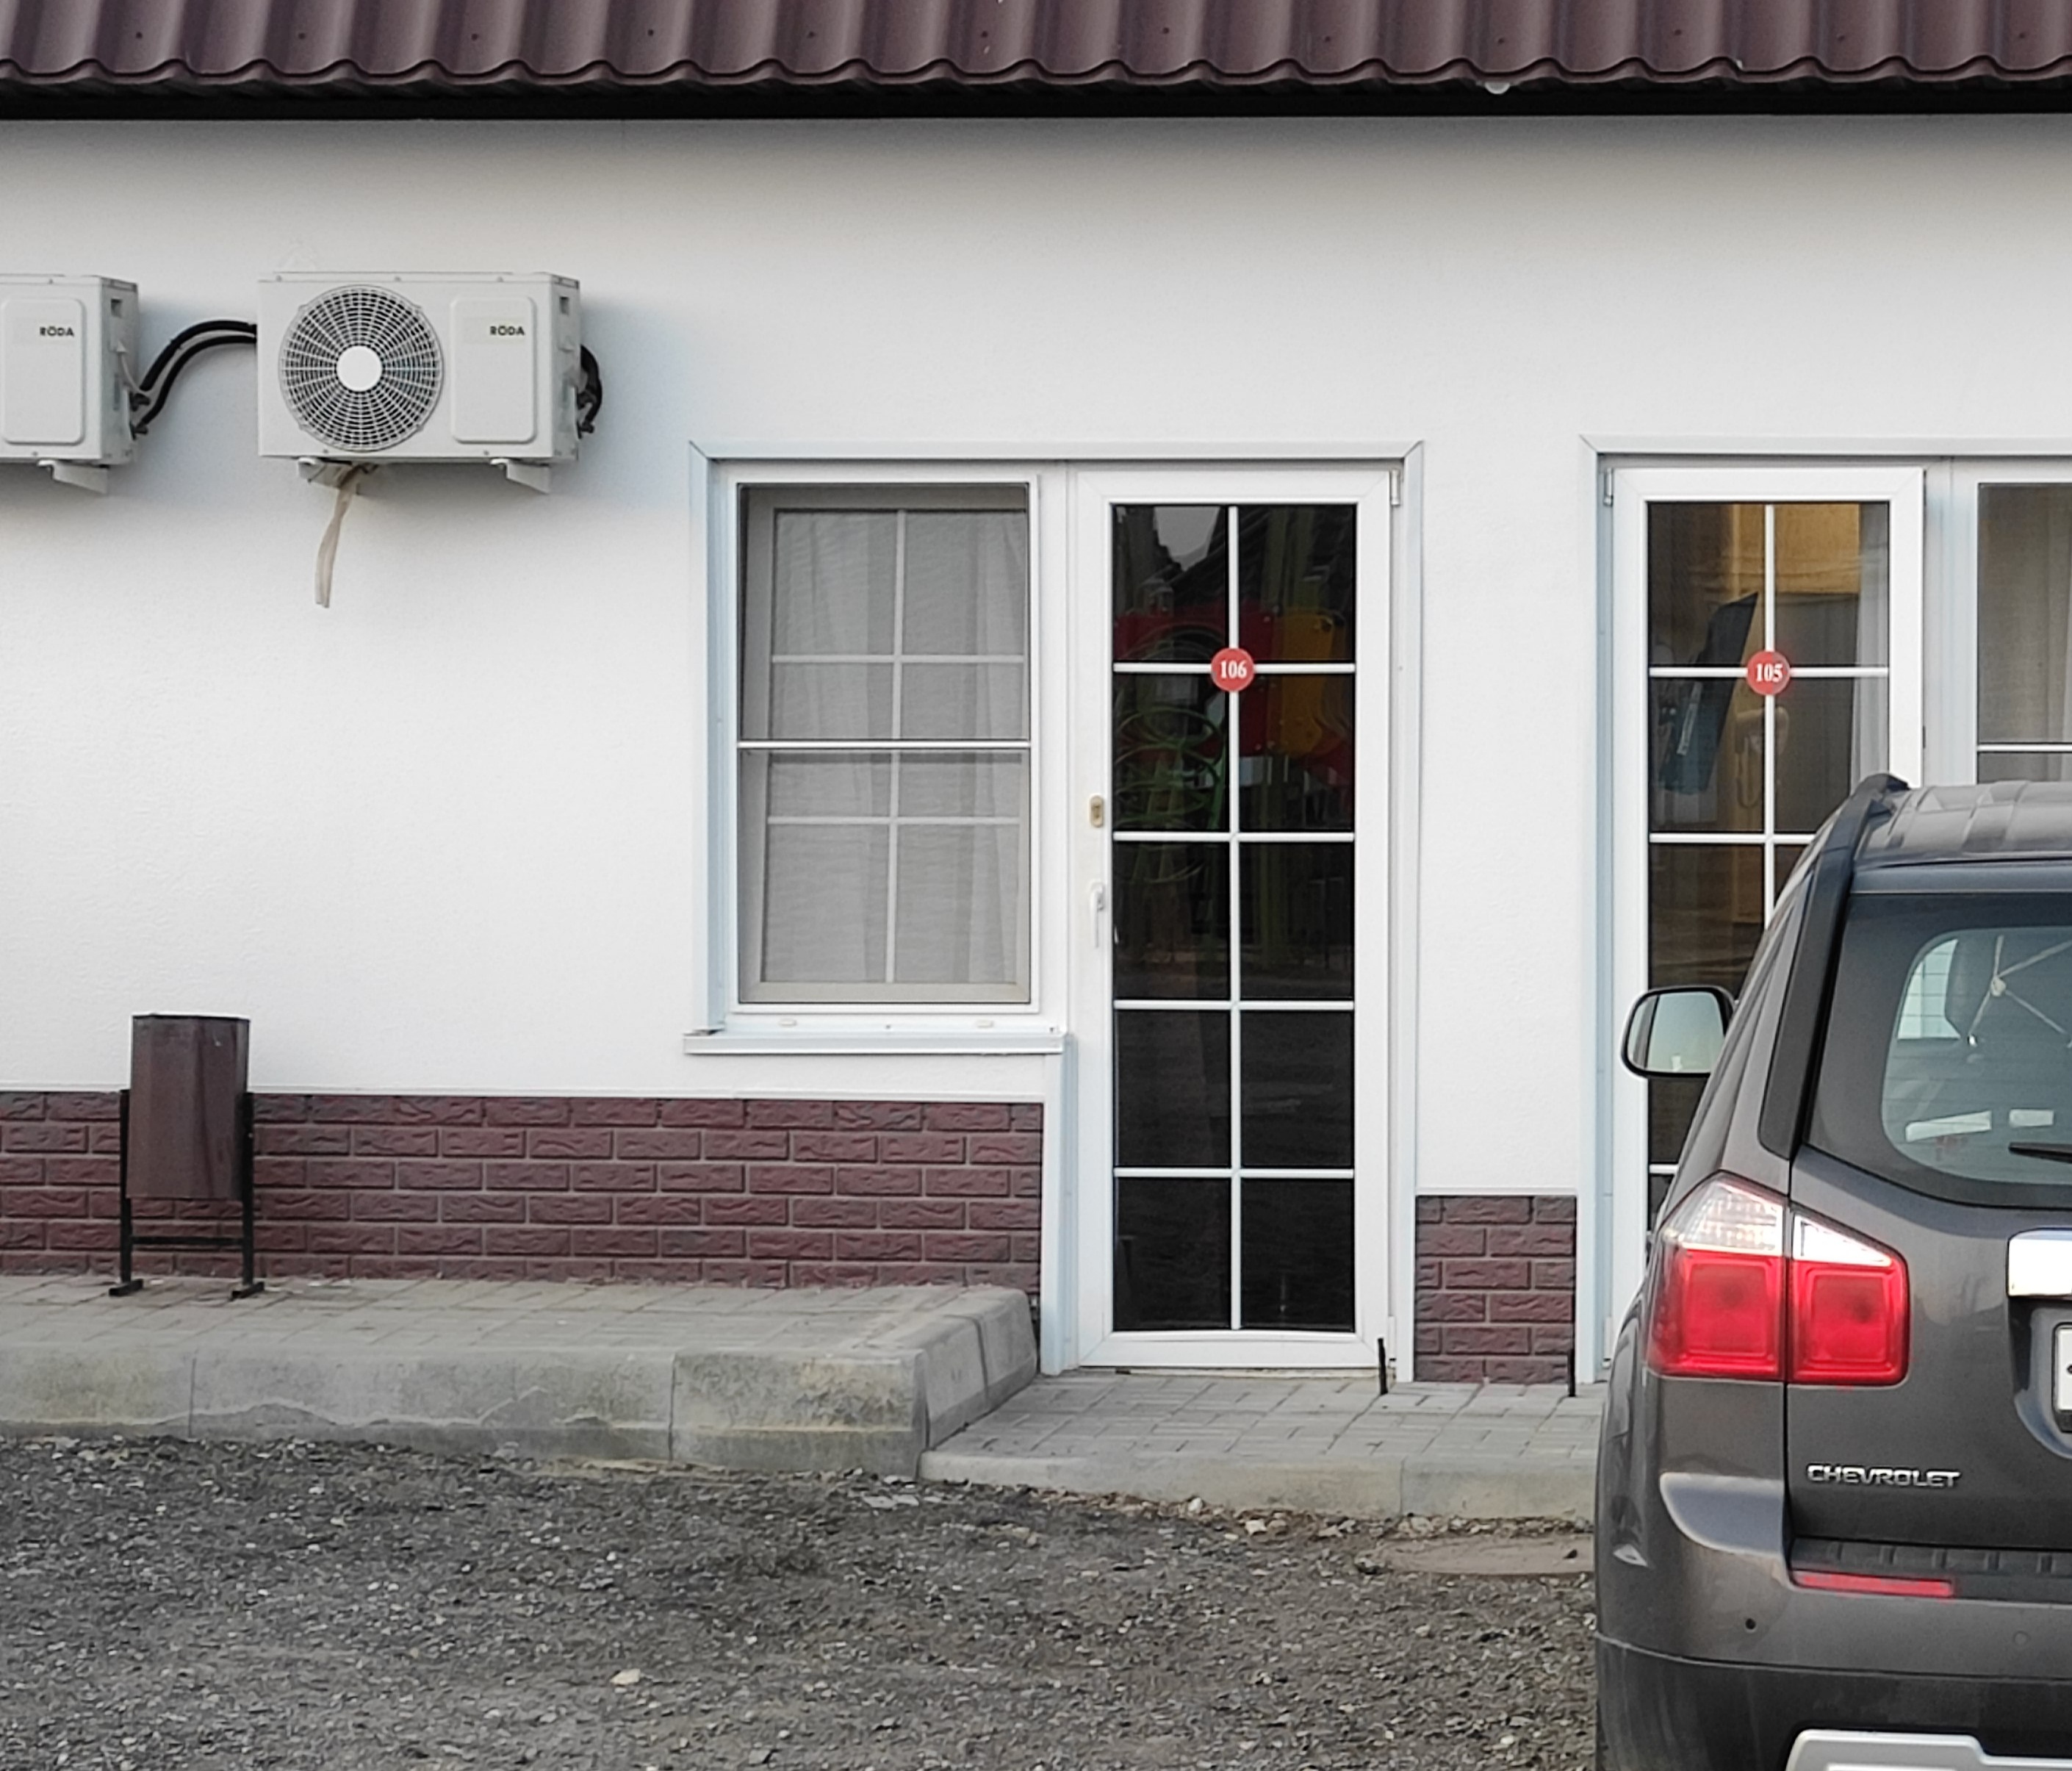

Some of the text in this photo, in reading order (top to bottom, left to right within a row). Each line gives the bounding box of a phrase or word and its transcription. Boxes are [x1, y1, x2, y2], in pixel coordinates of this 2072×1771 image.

[1220, 660, 1248, 680] 106
[1756, 663, 1783, 683] 105
[1807, 1465, 1961, 1488] CHEVROLET
